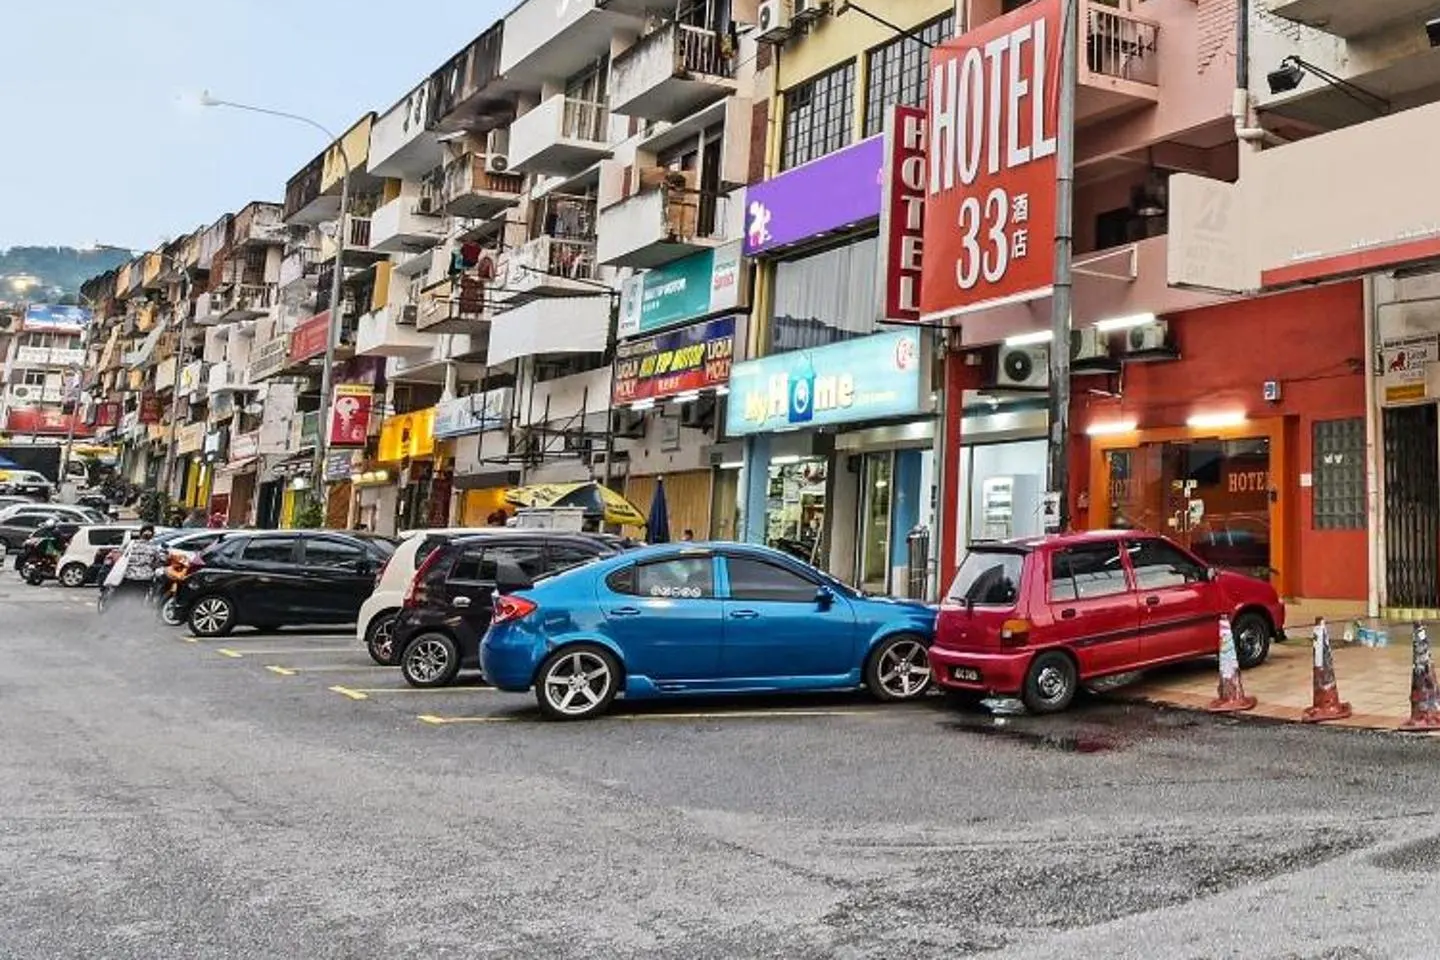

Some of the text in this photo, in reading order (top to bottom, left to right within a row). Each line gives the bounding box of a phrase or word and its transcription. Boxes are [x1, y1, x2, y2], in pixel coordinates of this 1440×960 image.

[931, 17, 1056, 195] HOTEL
[899, 115, 926, 311] HOTEL
[956, 188, 1008, 289] 33
[1011, 193, 1028, 258] 酒店
